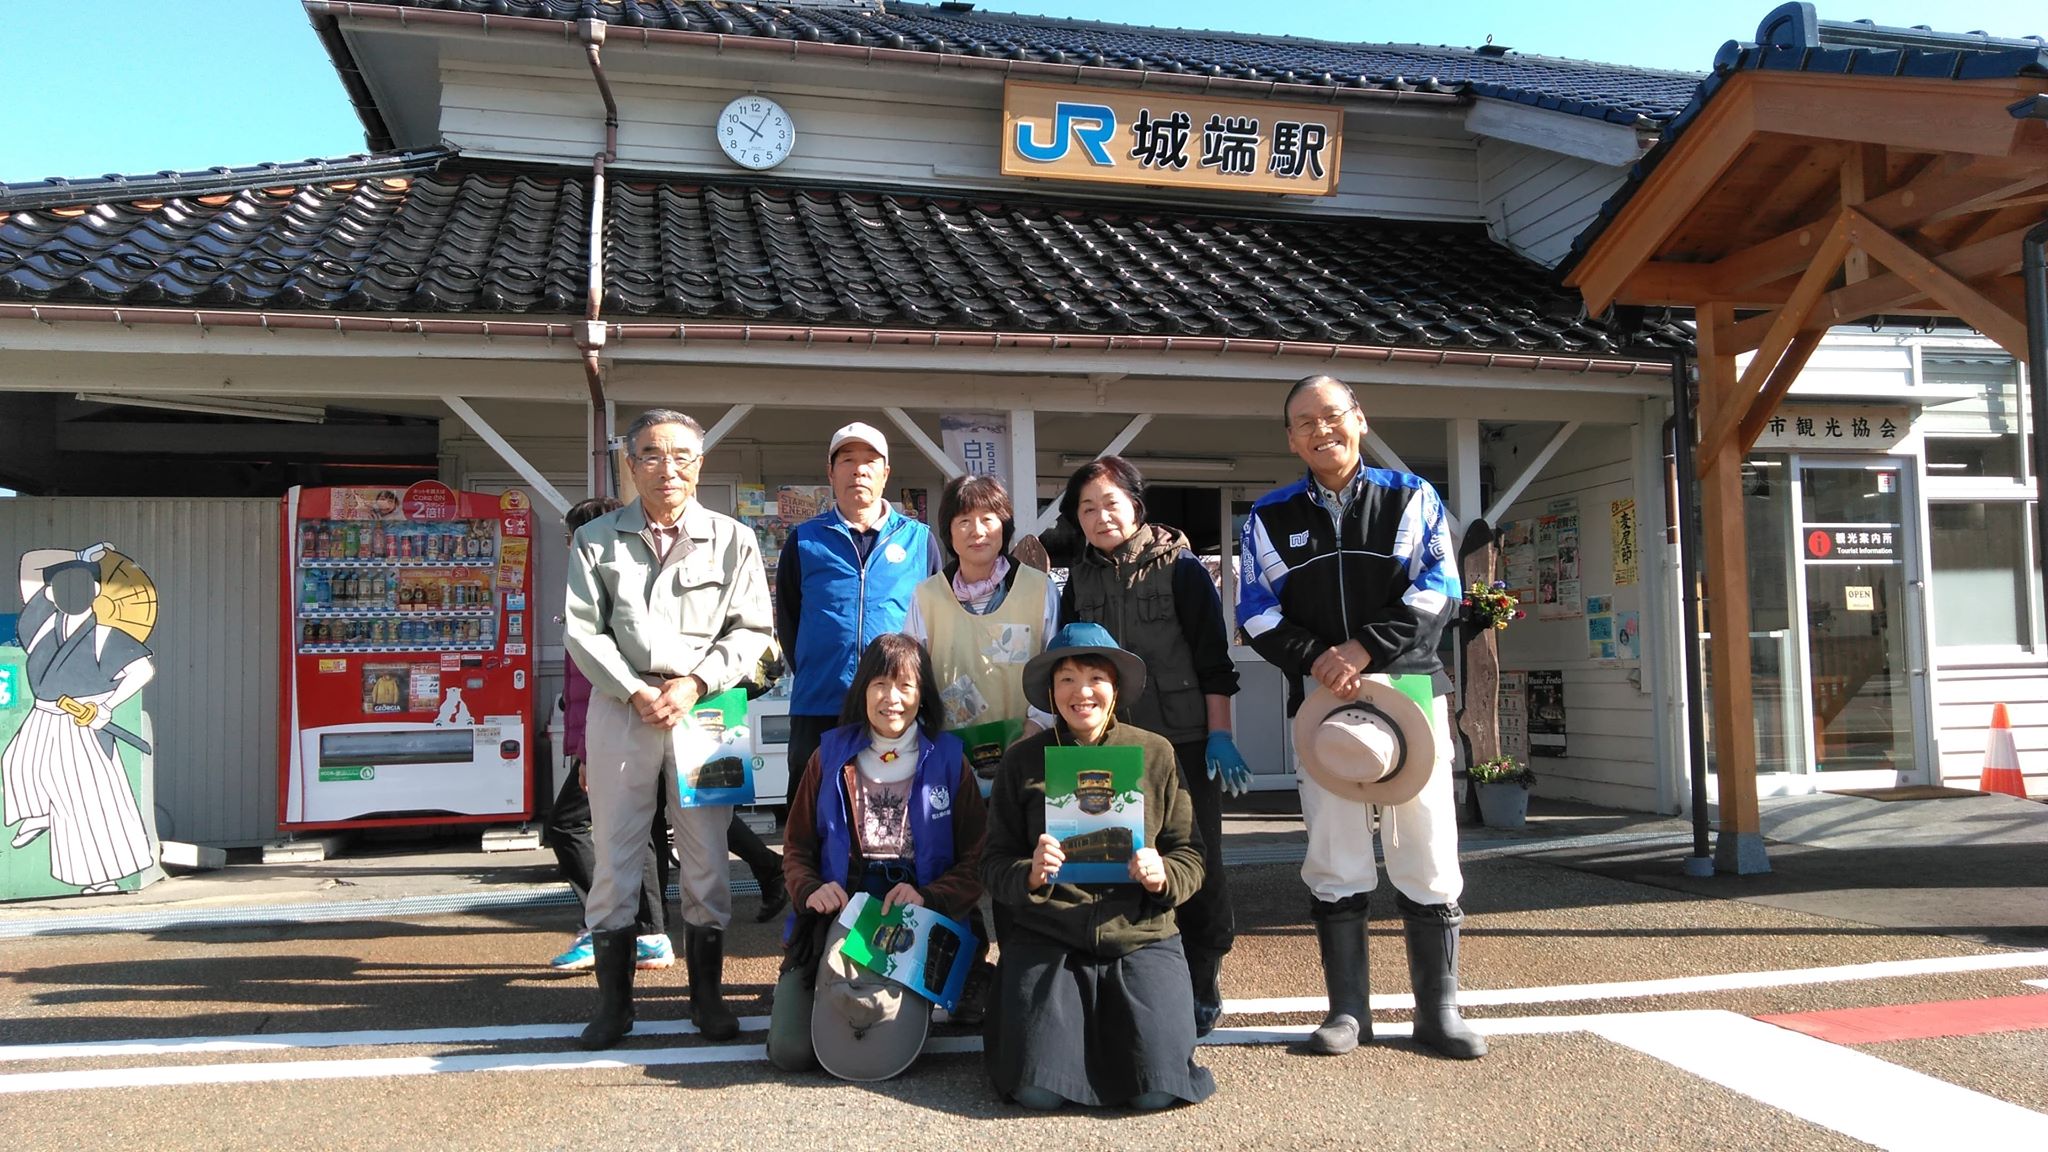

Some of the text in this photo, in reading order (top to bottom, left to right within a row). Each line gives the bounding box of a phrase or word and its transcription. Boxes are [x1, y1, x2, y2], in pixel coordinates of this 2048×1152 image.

[739, 106, 746, 114] 11
[751, 103, 760, 112] 12
[729, 114, 739, 123] 10
[775, 117, 781, 126] 2
[727, 127, 733, 135] 9
[779, 130, 785, 139] 3
[731, 140, 737, 149] 8
[1017, 101, 1327, 179] JR 城端駅
[776, 143, 781, 151] 4
[741, 150, 746, 158] 7
[753, 154, 760, 163] 6
[767, 151, 773, 160] 5
[1768, 416, 1897, 437] 市観光協会
[782, 505, 814, 516] ENERGY
[1835, 532, 1892, 544] 観光案内所
[1848, 590, 1871, 599] OPEN
